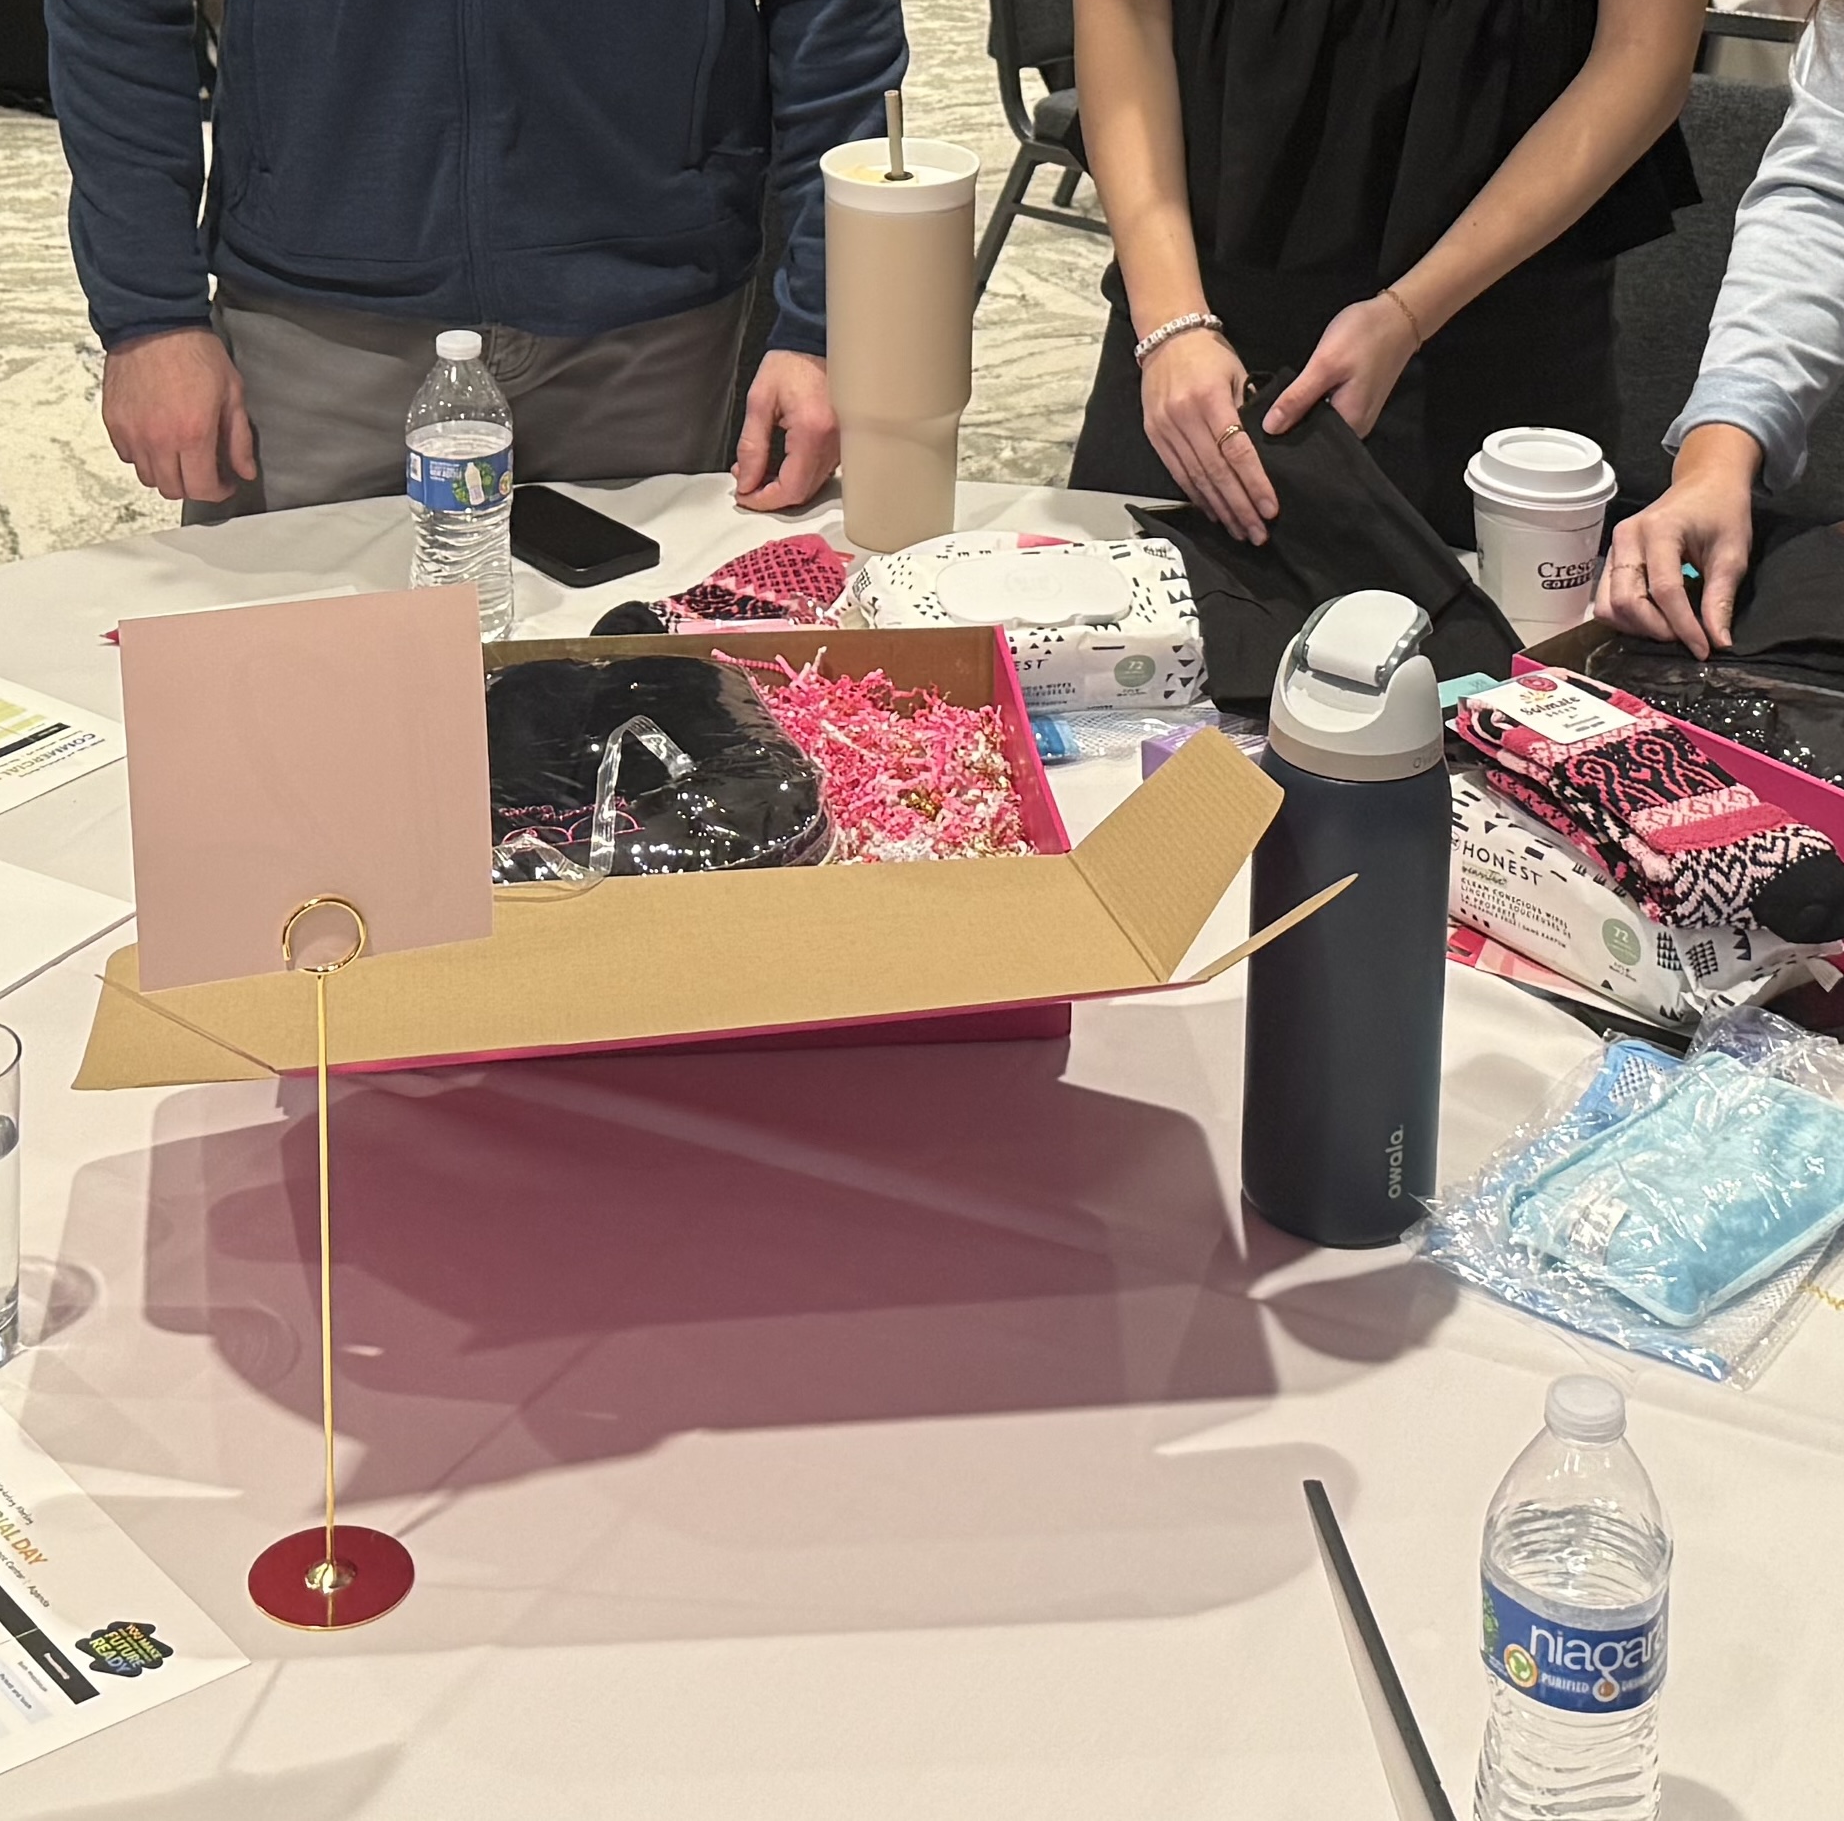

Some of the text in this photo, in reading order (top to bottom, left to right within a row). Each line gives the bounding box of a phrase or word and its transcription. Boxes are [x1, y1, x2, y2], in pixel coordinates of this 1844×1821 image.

[1462, 840, 1543, 886] HONEST
[10, 1537, 49, 1567] DAY
[87, 1636, 132, 1675] READY
[102, 1630, 147, 1669] FUTURE
[122, 1623, 145, 1640] YOU
[136, 1637, 164, 1660] MAKE
[1541, 1672, 1590, 1693] PURIFIED
